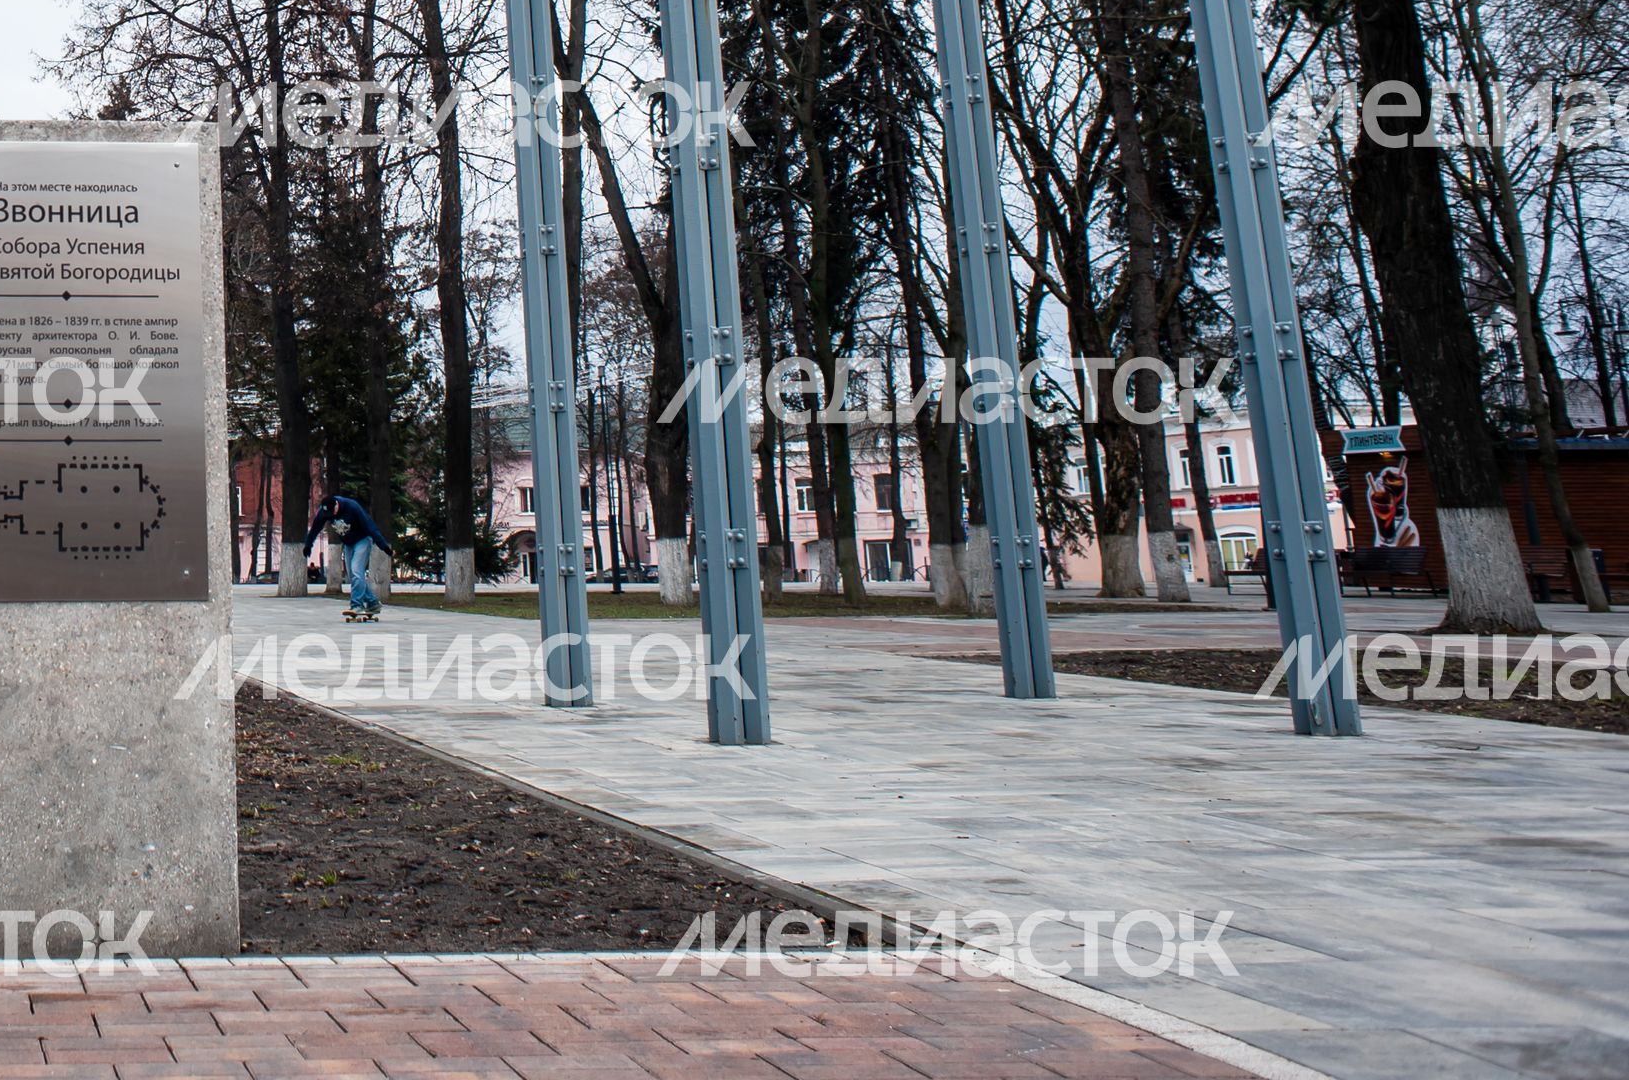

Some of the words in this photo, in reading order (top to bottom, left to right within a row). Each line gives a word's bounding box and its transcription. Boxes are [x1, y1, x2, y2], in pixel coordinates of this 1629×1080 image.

[11, 183, 37, 192] этом
[39, 183, 72, 192] месте
[74, 183, 138, 194] находилась
[66, 237, 145, 256] Успения
[61, 263, 181, 284] Богородицы
[29, 316, 54, 326] 1826
[64, 316, 89, 327] 1839
[91, 318, 103, 327] гг.
[113, 318, 143, 327] стиле
[144, 318, 179, 328] ампир
[32, 332, 98, 342] архитектора
[108, 331, 120, 341] О.
[129, 331, 141, 341] И.
[150, 331, 179, 341] Бове.
[49, 347, 112, 355] колокольня
[129, 345, 179, 356] обладала
[85, 359, 133, 369] большой
[135, 360, 179, 369] колокол
[31, 419, 77, 429] взорван
[78, 418, 92, 428] 17
[92, 419, 132, 429] апреля
